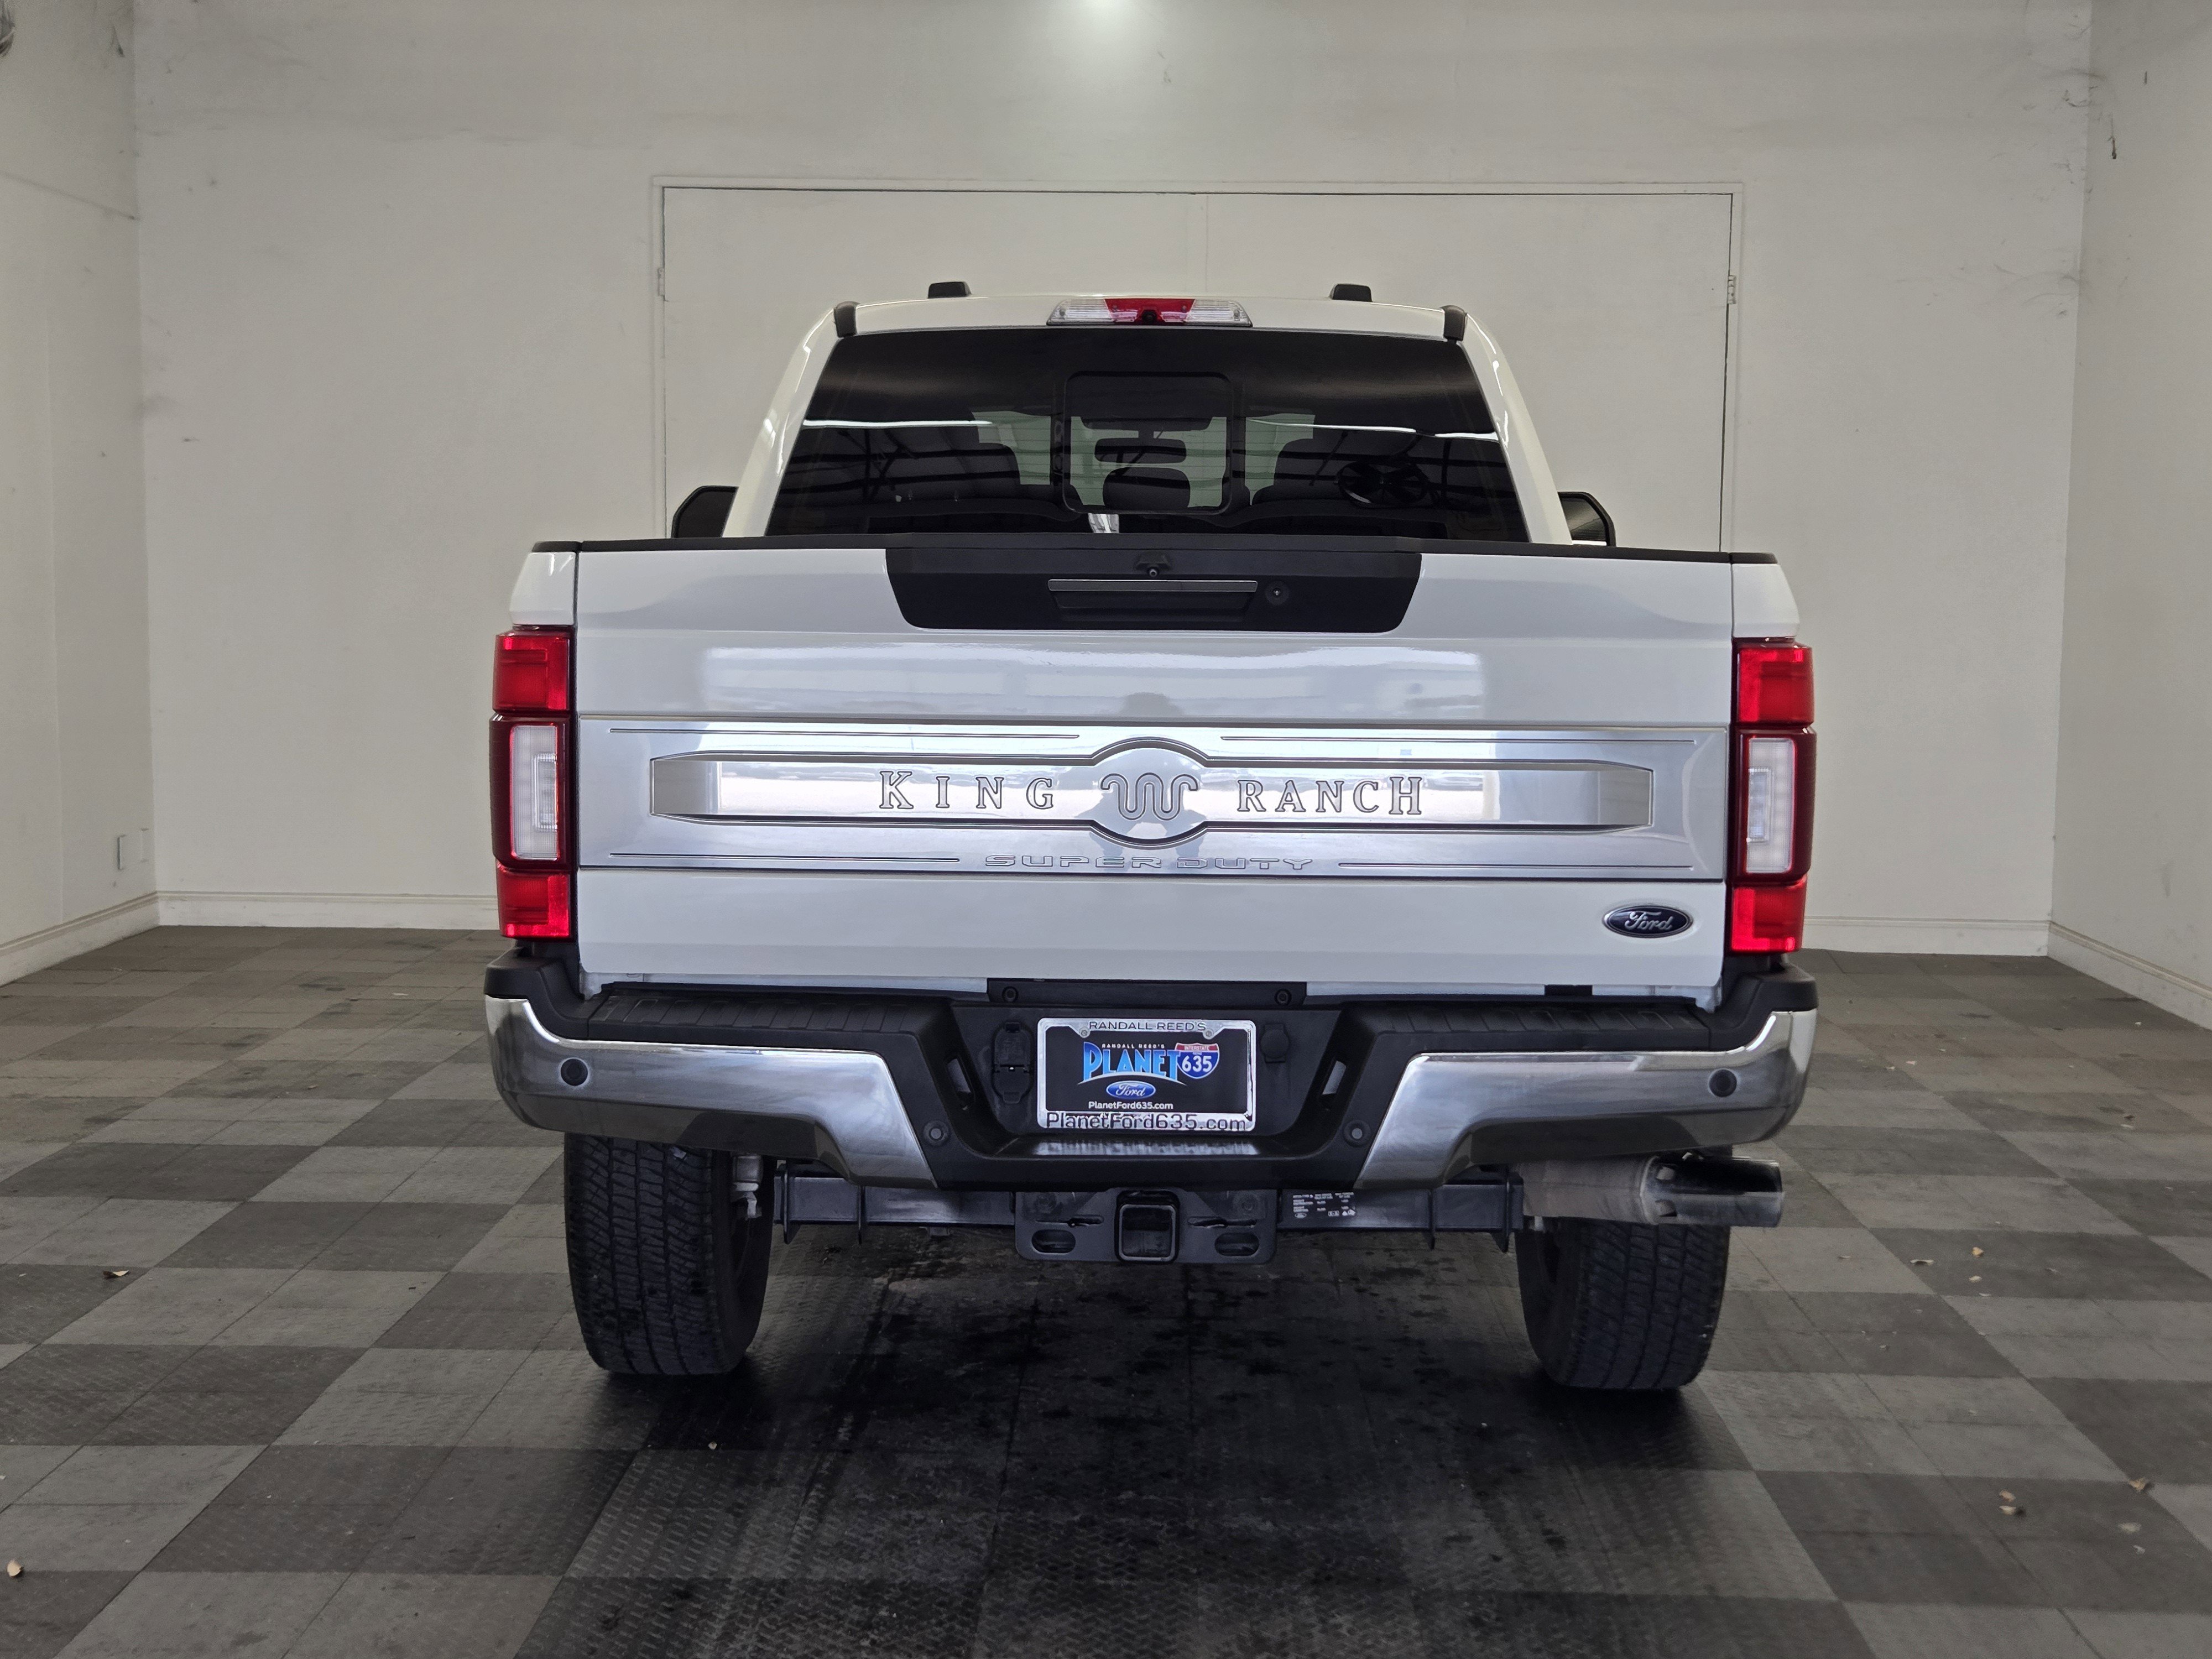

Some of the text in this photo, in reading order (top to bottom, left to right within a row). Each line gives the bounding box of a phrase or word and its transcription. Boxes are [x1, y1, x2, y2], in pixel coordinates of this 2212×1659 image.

[879, 770, 1422, 816] KING RANCH
[985, 854, 1313, 870] SUPER DUTY
[1624, 910, 1674, 931] Ford
[1088, 1021, 1207, 1031] RANDALL REED'S
[1083, 1041, 1181, 1081] PLANET
[1182, 1055, 1213, 1072] 635
[1115, 1081, 1146, 1097] Ford
[1088, 1100, 1174, 1110] PlanetFord635.com
[1046, 1112, 1246, 1130] PlanetFord635.com
